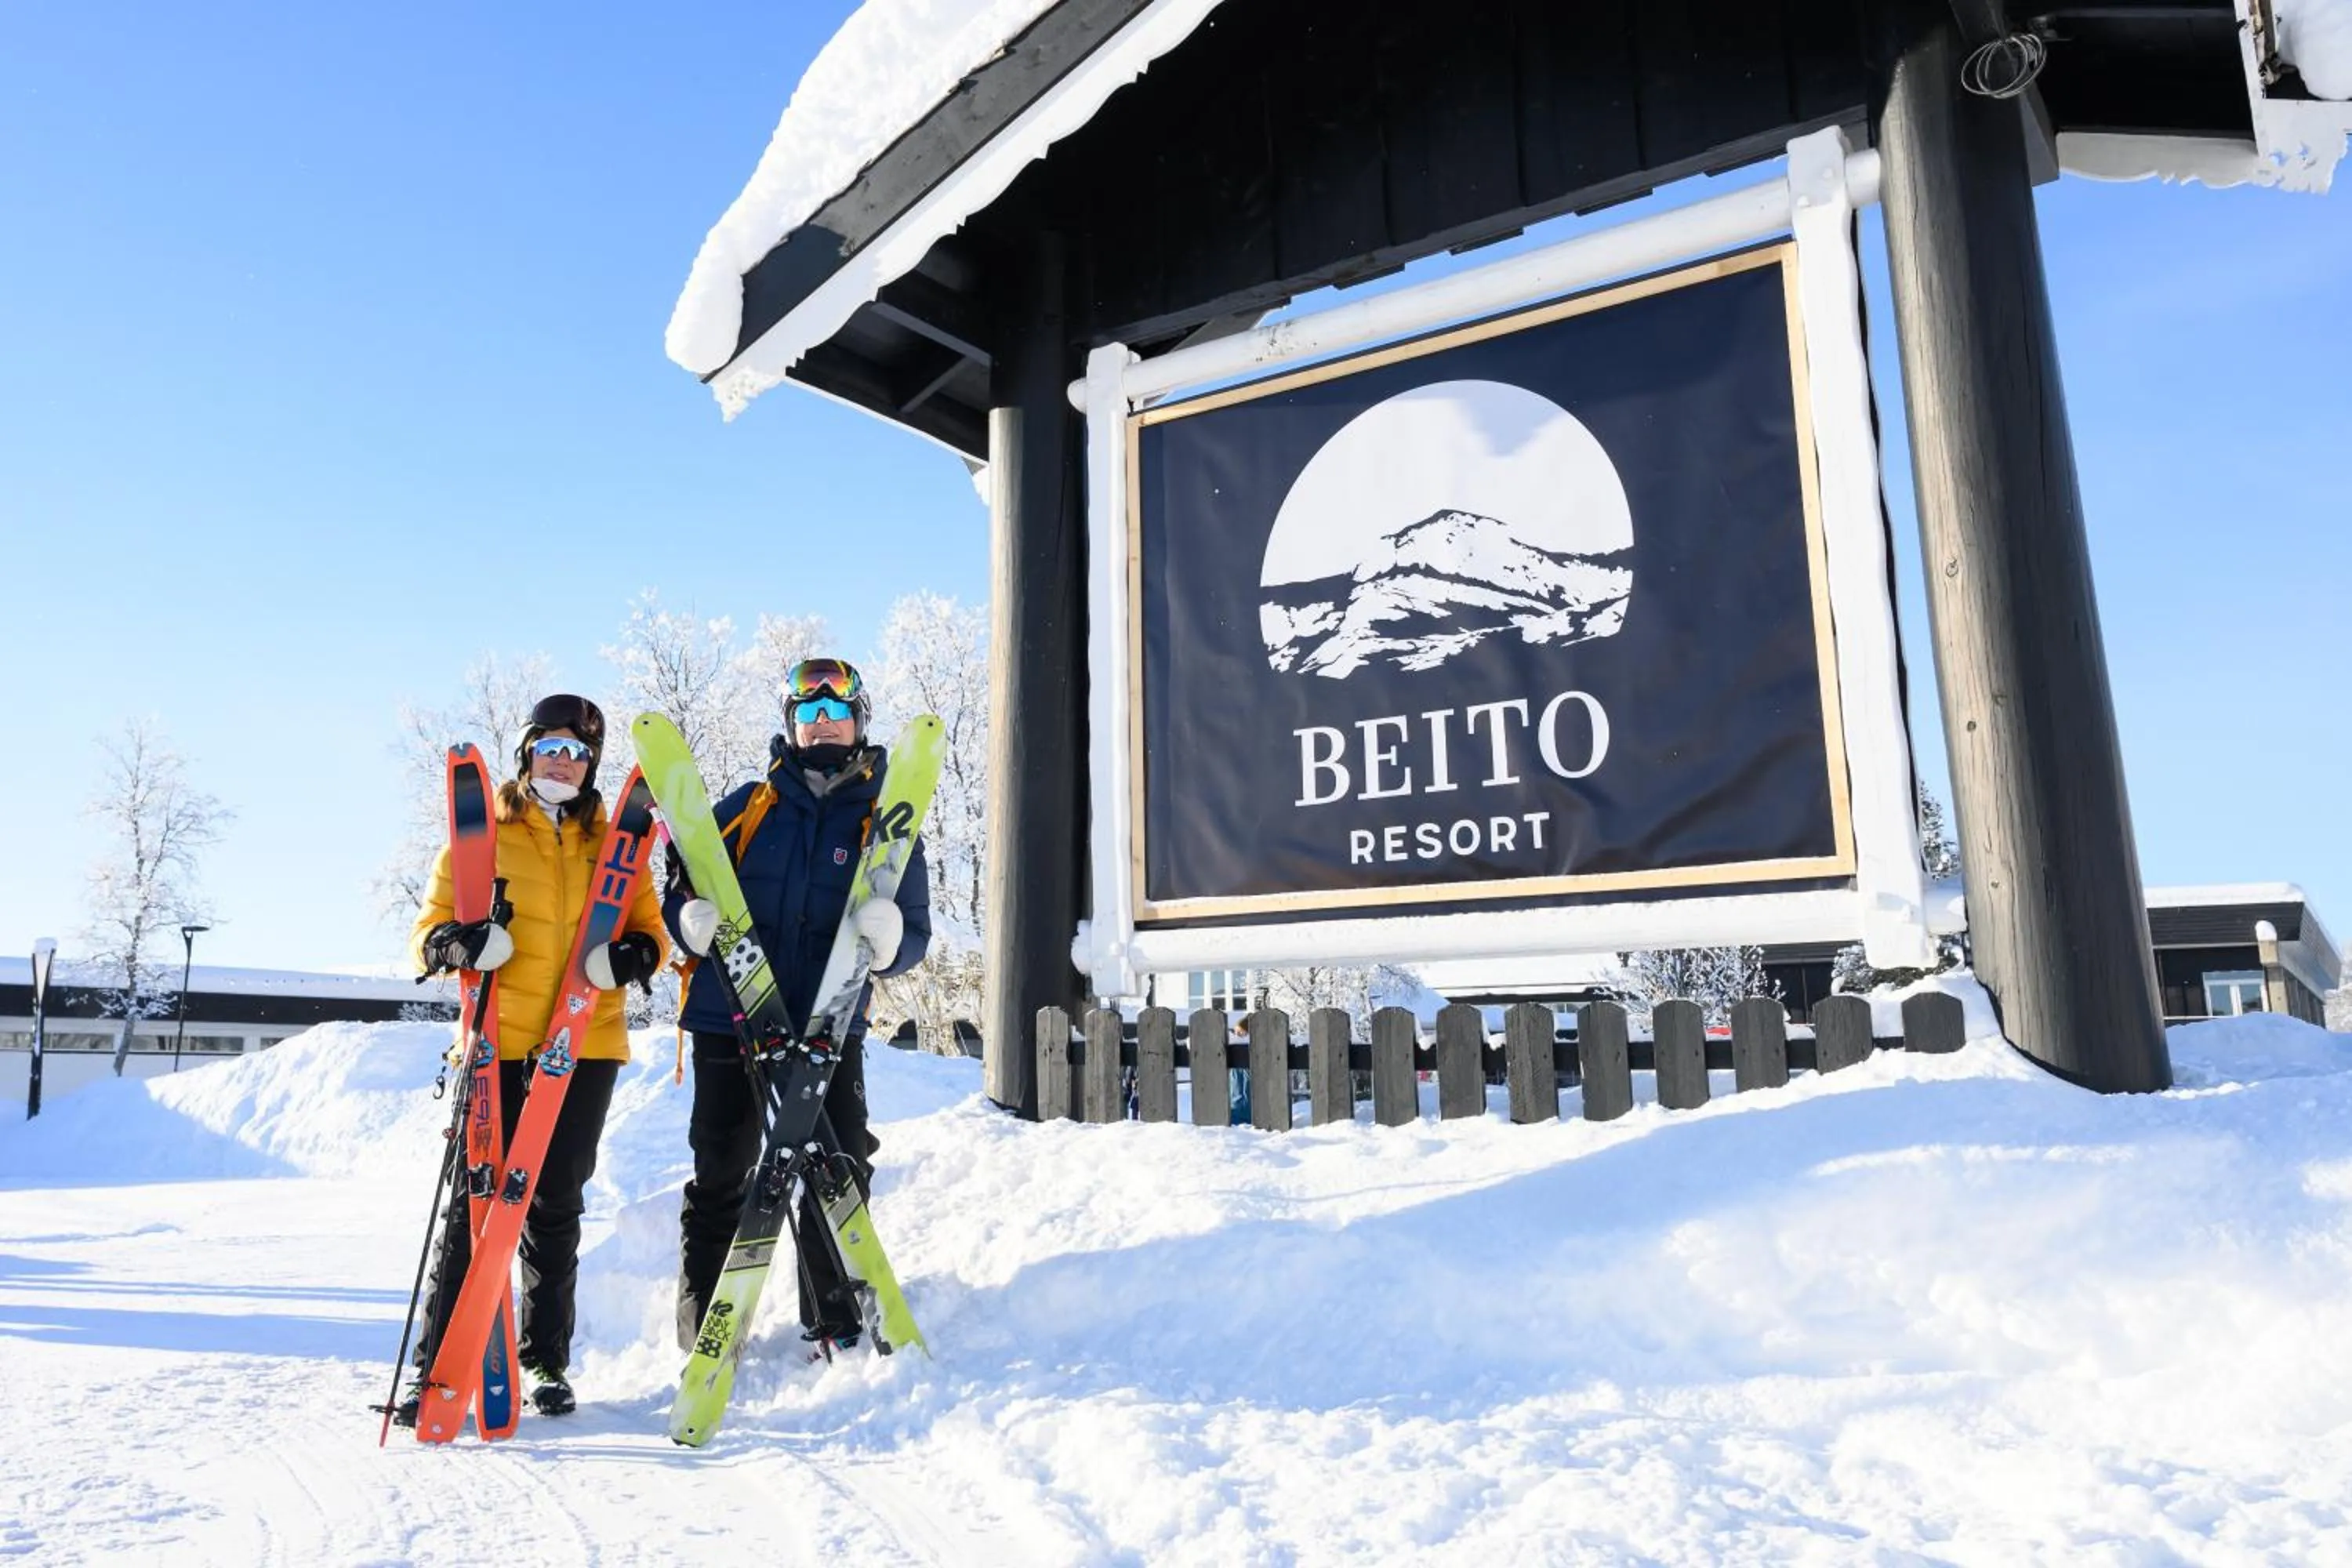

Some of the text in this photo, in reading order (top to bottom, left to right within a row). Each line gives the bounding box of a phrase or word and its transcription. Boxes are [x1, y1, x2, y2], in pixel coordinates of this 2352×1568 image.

[1293, 691, 1610, 807] BEITO
[865, 801, 914, 847] K2
[1350, 811, 1549, 864] RESORT
